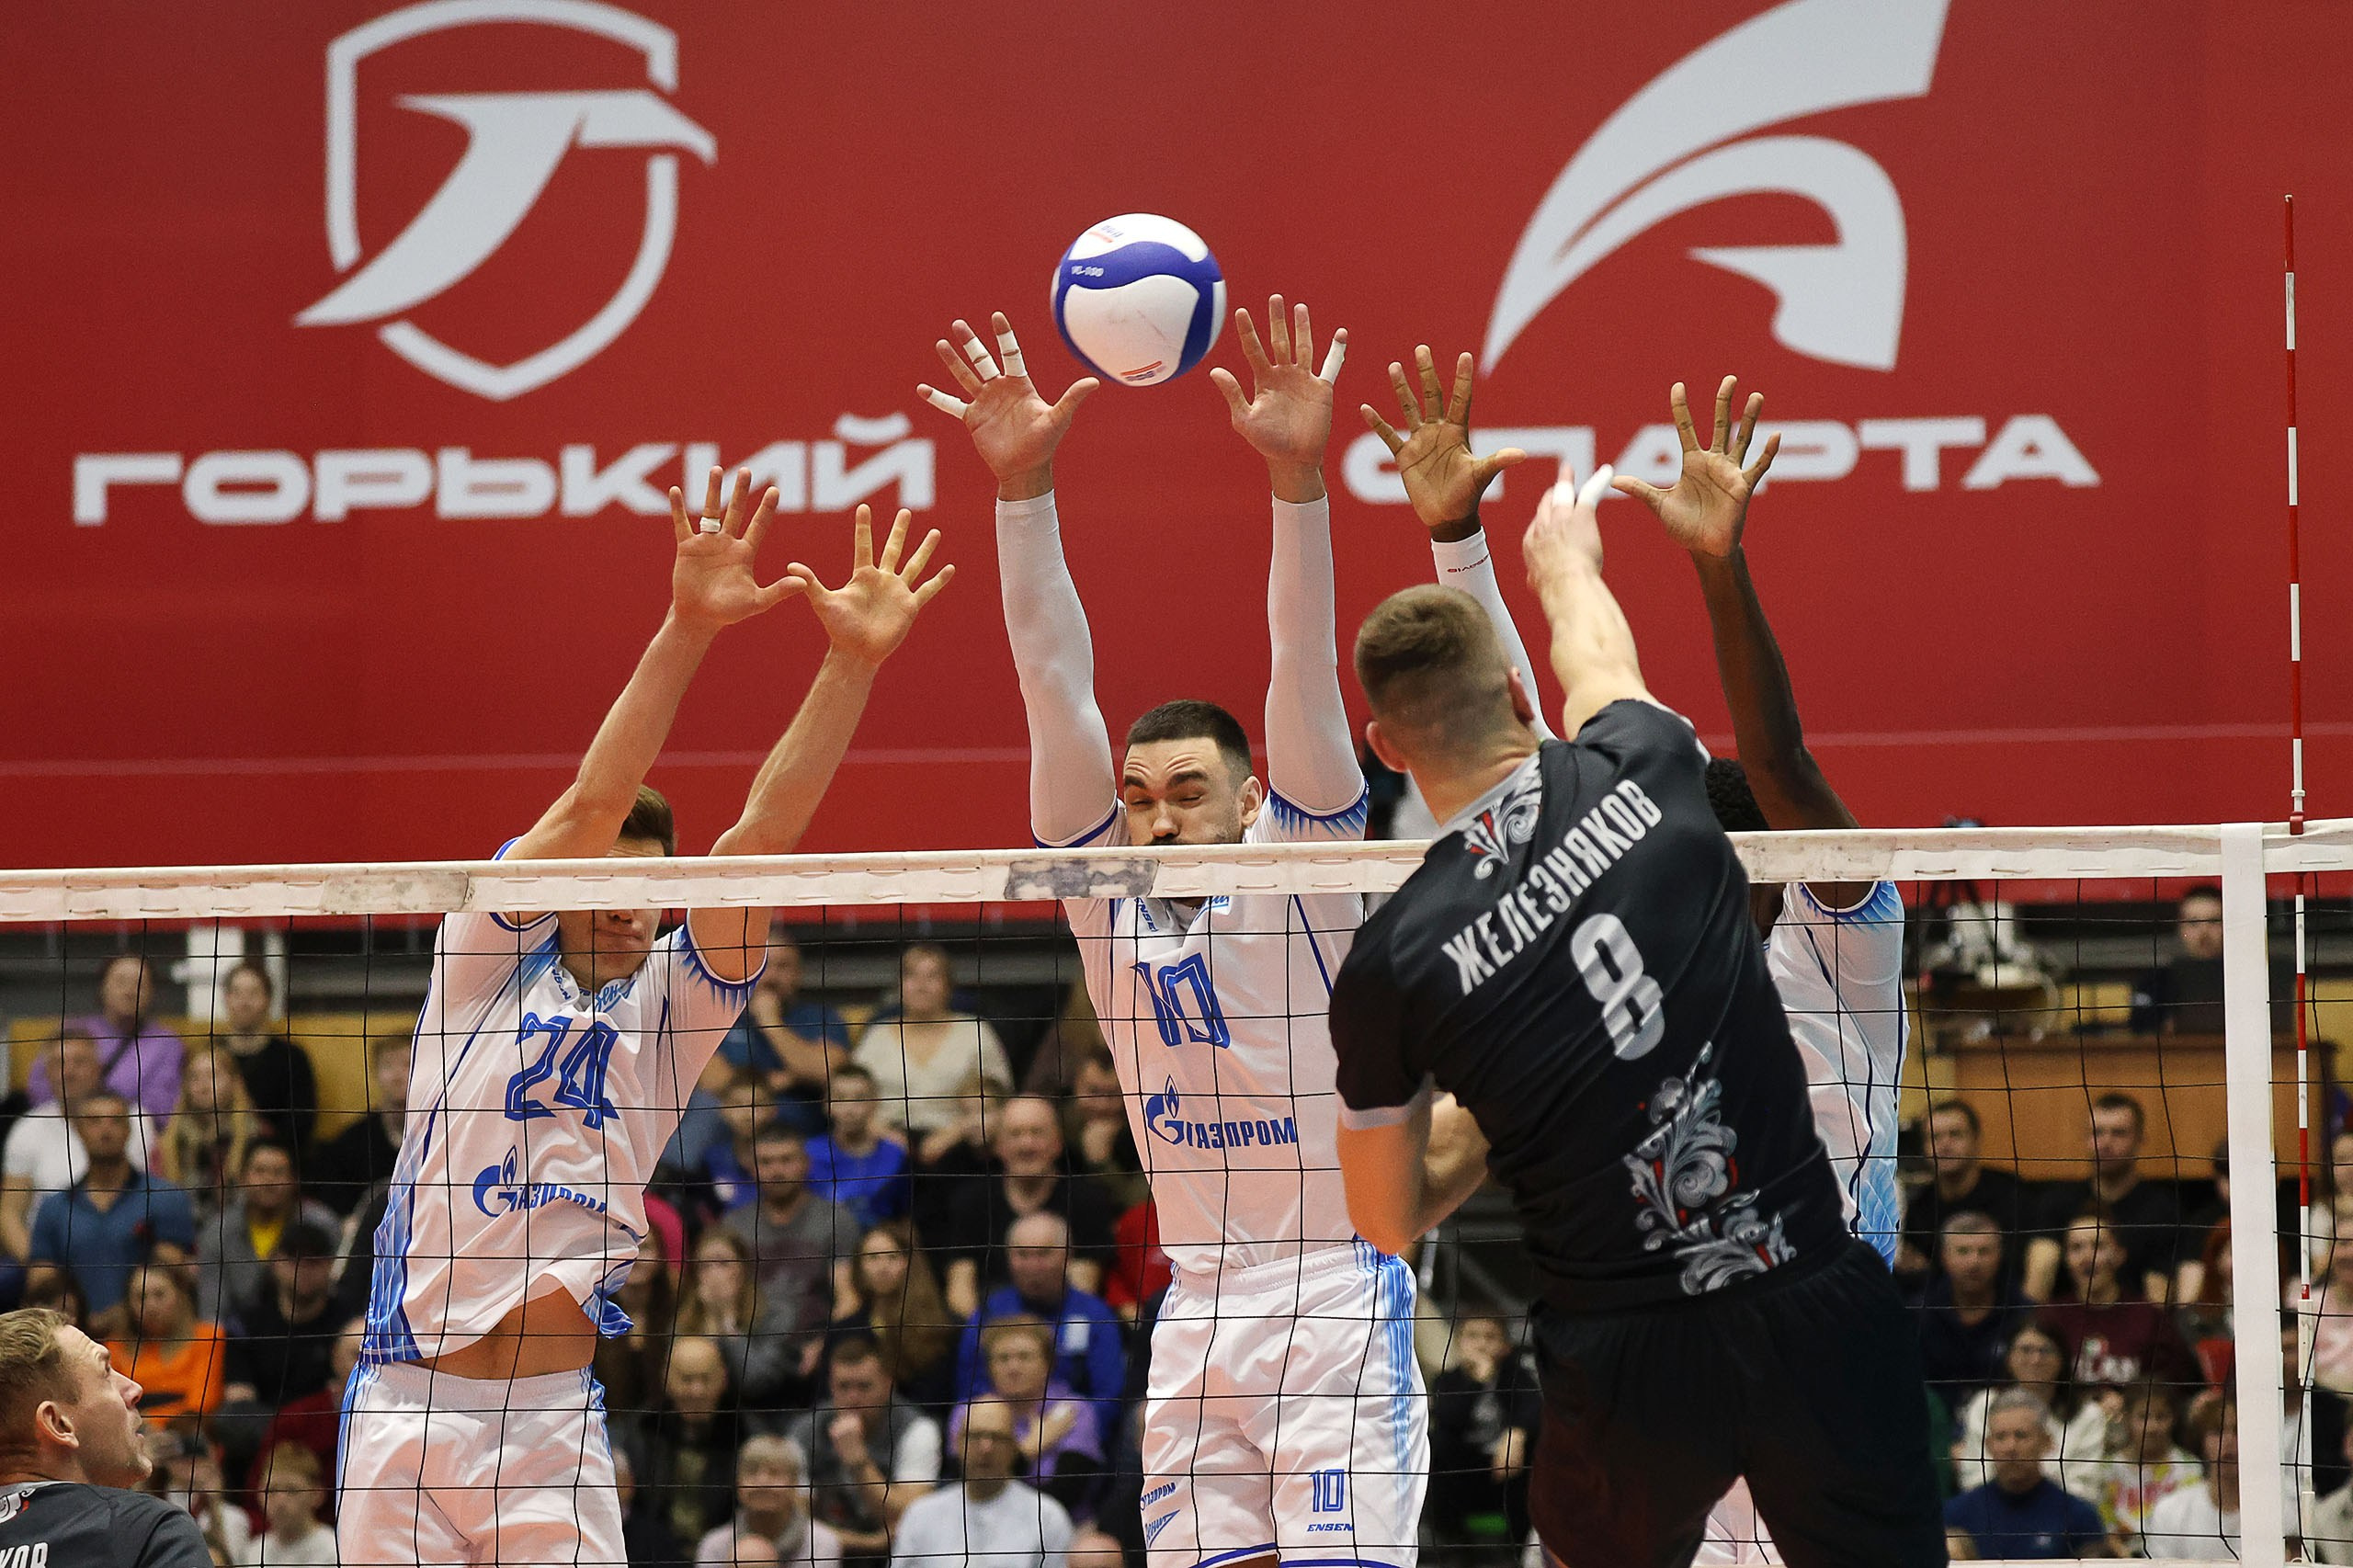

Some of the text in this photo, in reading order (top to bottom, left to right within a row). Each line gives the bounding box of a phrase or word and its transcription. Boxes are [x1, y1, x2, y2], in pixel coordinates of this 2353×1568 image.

[72, 413, 936, 526] ГОРЬКИЙ
[1440, 778, 1663, 995] ЖЕЛЕЗНЯКОВ
[1130, 952, 1231, 1049] 10
[1570, 913, 1665, 1061] 8
[504, 1012, 620, 1131] 24
[1307, 1523, 1354, 1532] ENSEN
[1308, 1469, 1345, 1513] 10
